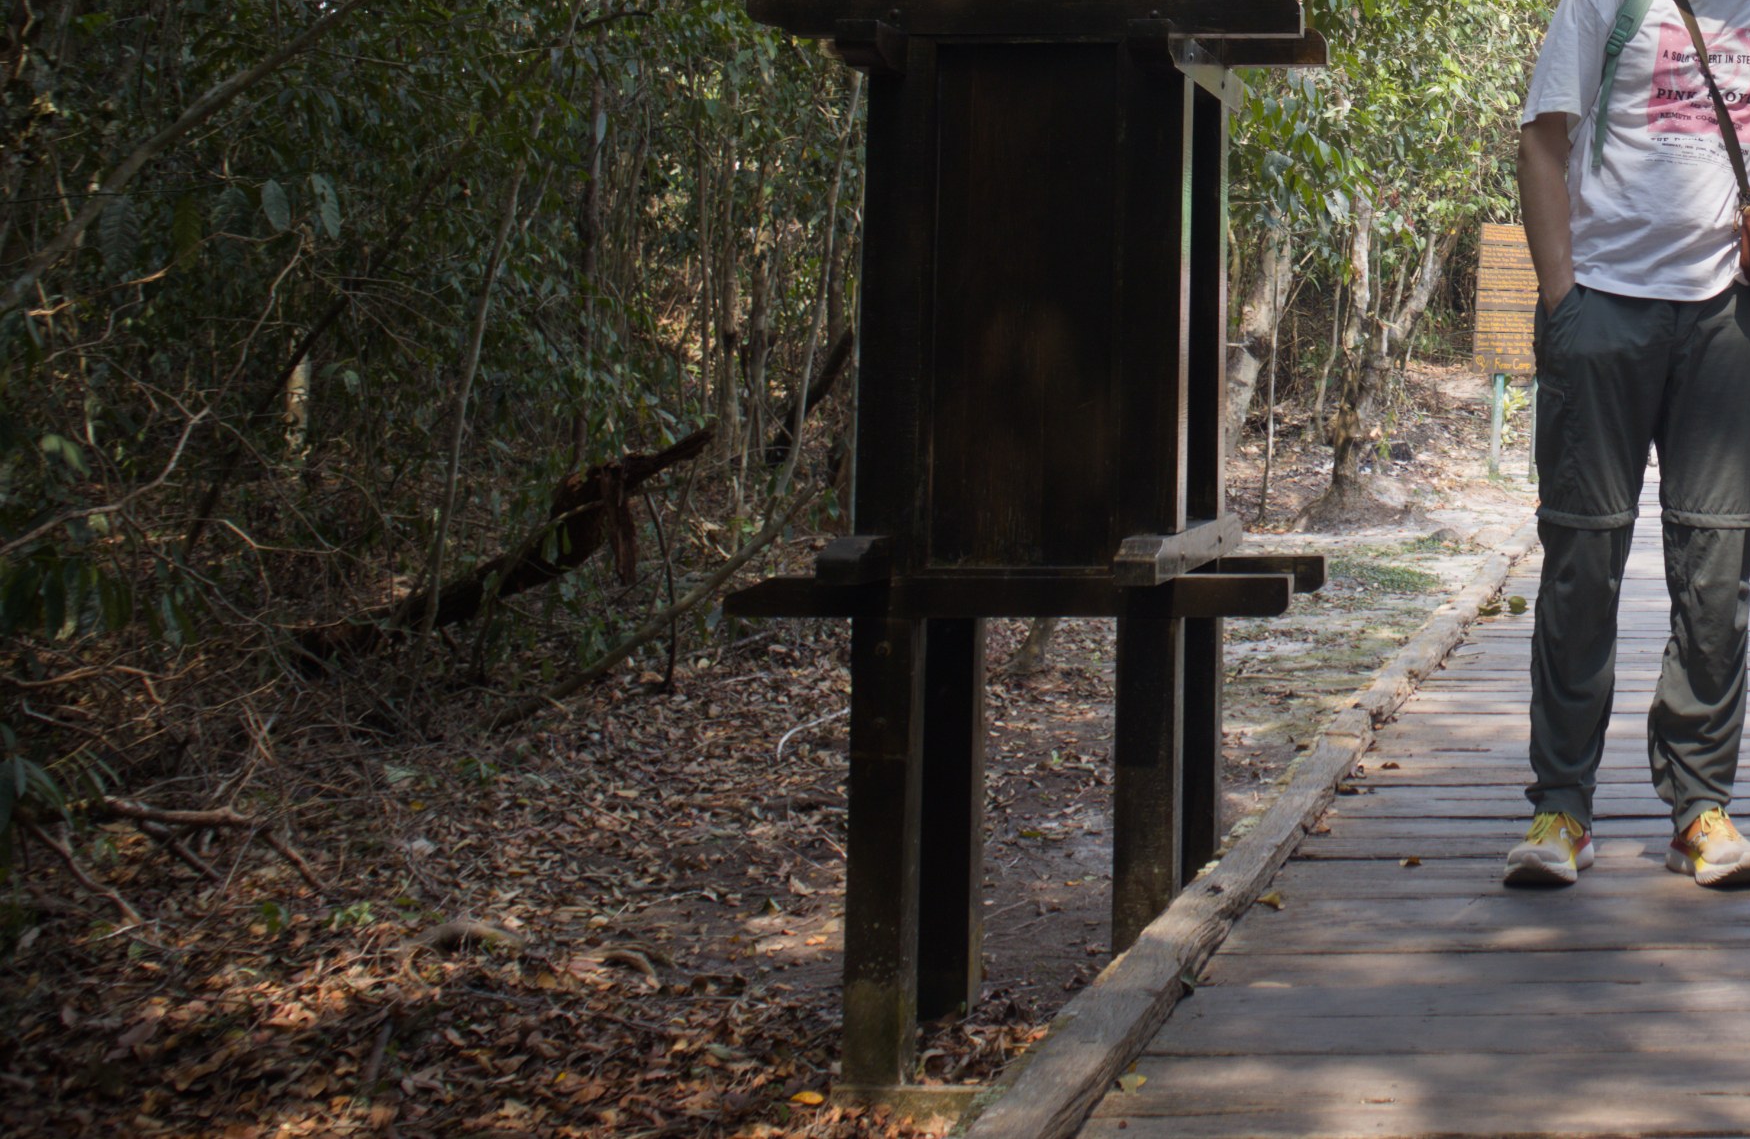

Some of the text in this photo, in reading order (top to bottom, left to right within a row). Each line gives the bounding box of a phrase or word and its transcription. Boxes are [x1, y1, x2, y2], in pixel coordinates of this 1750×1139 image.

[1662, 49, 1669, 59] A
[1725, 54, 1734, 64] IN
[1656, 88, 1698, 101] PINK
